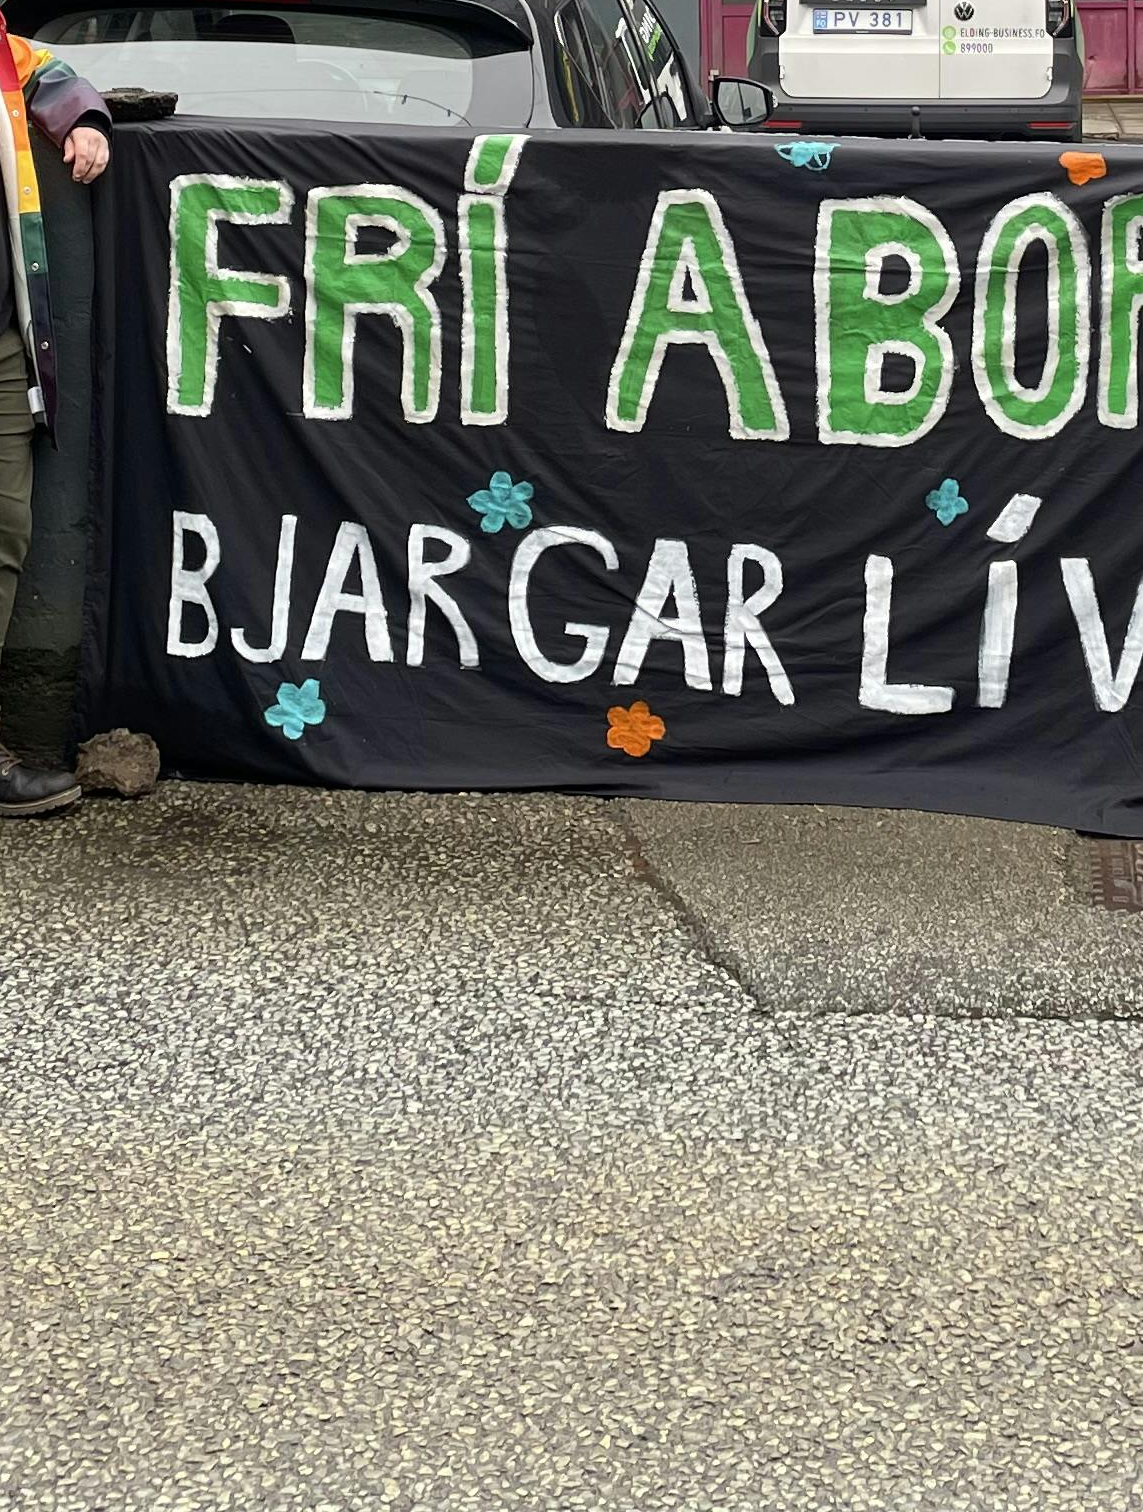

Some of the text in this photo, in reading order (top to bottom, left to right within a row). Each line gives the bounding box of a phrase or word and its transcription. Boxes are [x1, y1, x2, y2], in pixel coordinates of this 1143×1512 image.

[834, 11, 903, 27] PV 381
[960, 43, 993, 53] 899000
[166, 134, 531, 426] FRÍ
[166, 510, 796, 707] BJARGAR
